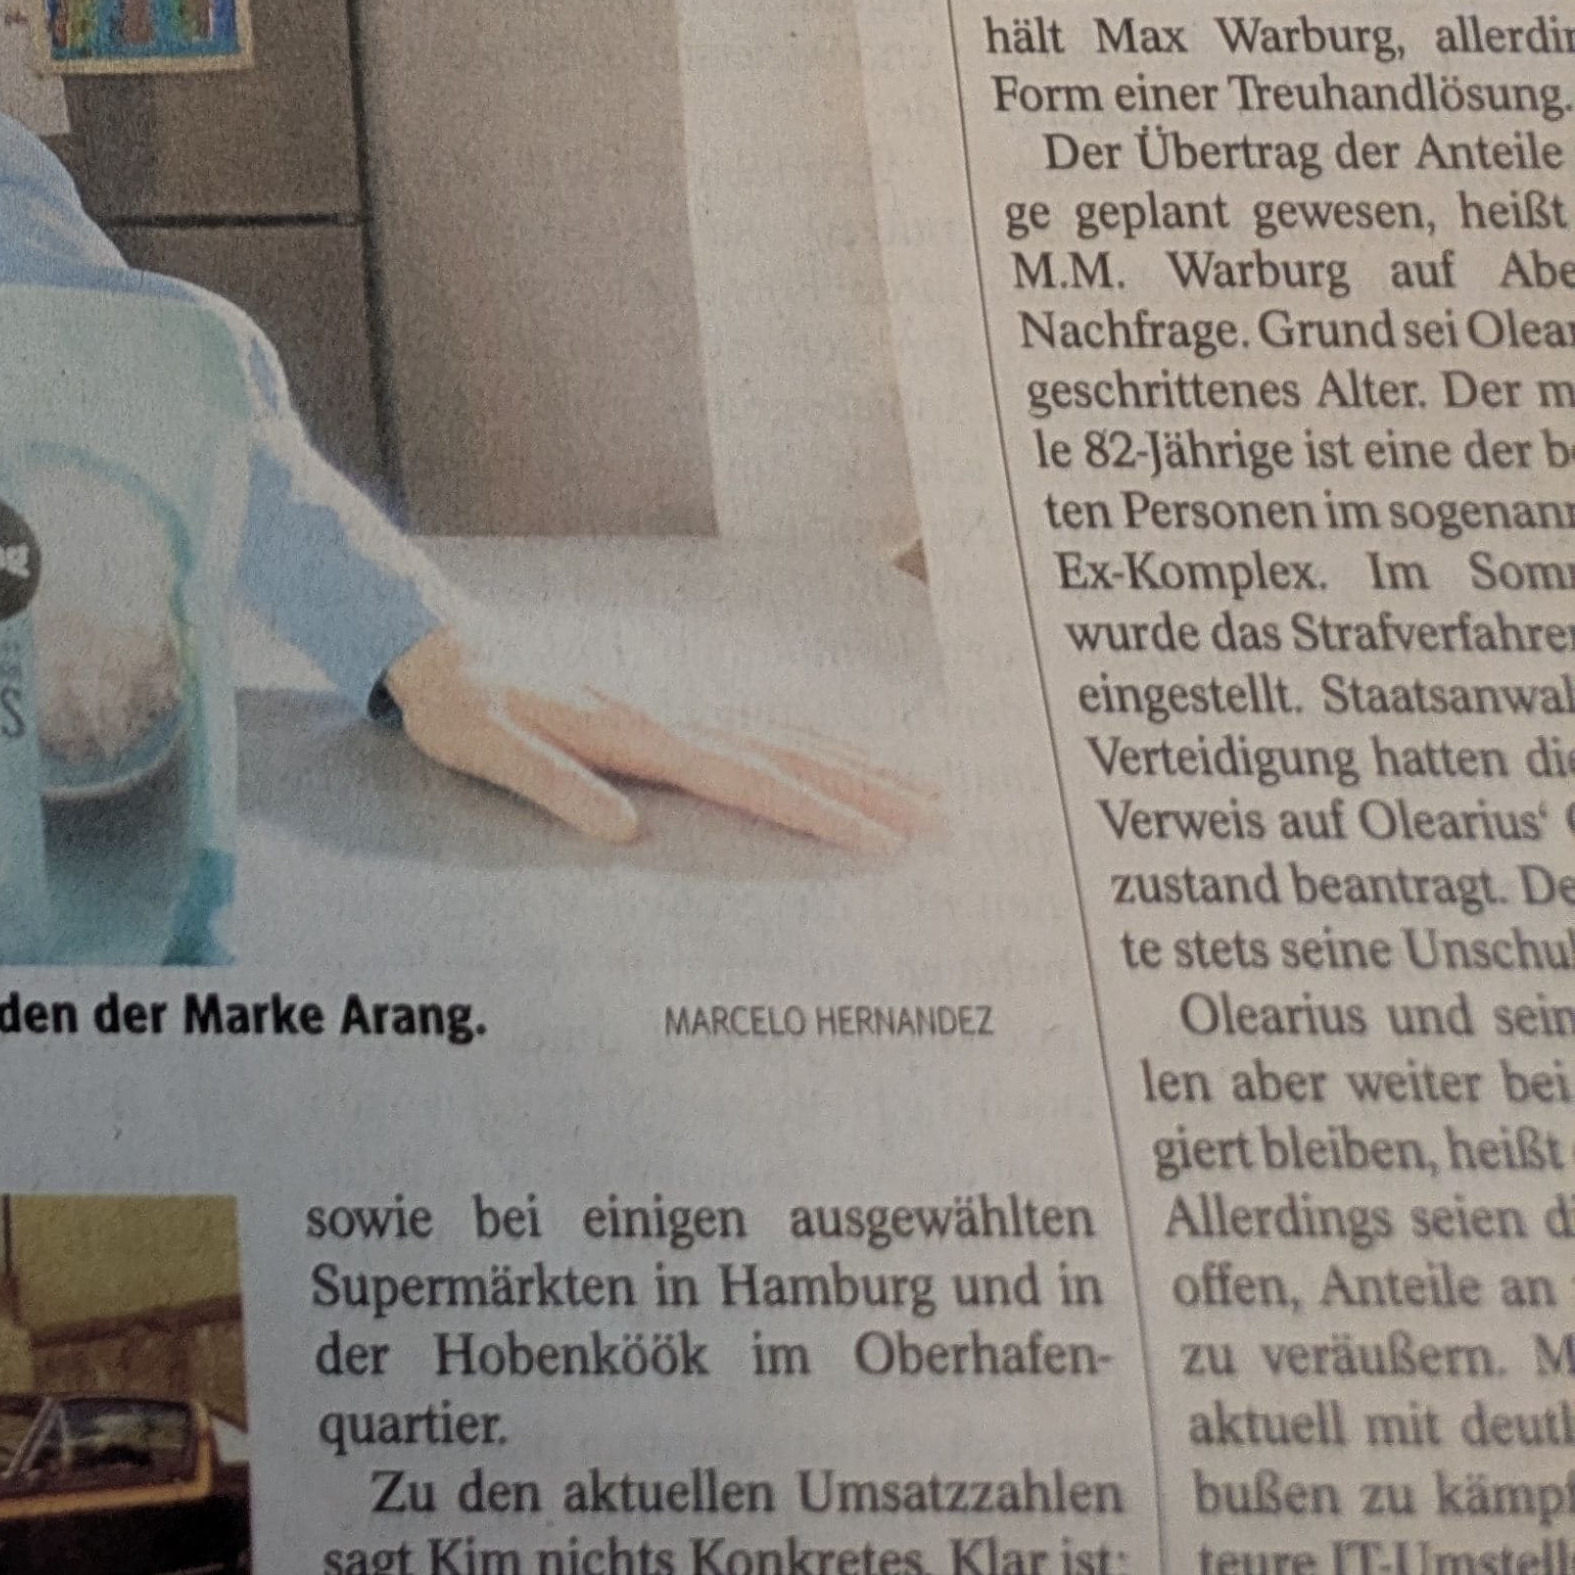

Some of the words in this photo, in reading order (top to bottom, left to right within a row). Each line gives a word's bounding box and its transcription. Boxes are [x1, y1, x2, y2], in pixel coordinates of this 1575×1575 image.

[991, 74, 1105, 113] Form
[1114, 72, 1219, 113] einer
[1226, 71, 1573, 123] Treuhandlösung.
[1033, 428, 1072, 469] le
[1084, 428, 1294, 480] 82-Jährige
[1304, 428, 1355, 470] ist
[1364, 428, 1452, 470] eine
[1464, 428, 1533, 470] der
[93, 991, 168, 1036] der
[183, 992, 325, 1036] Marke
[339, 992, 487, 1046] Arang.
[665, 1005, 807, 1038] MARCELO
[815, 1004, 995, 1037] HERNANDEZ
[311, 1261, 638, 1320] Supermärkten
[654, 1261, 700, 1308] in
[718, 1260, 937, 1319] Hamburg
[953, 1261, 1042, 1307] und
[1059, 1261, 1104, 1307] in
[1172, 1260, 1301, 1314] offen,
[1319, 1261, 1482, 1309] Anteile
[1500, 1275, 1558, 1309] an
